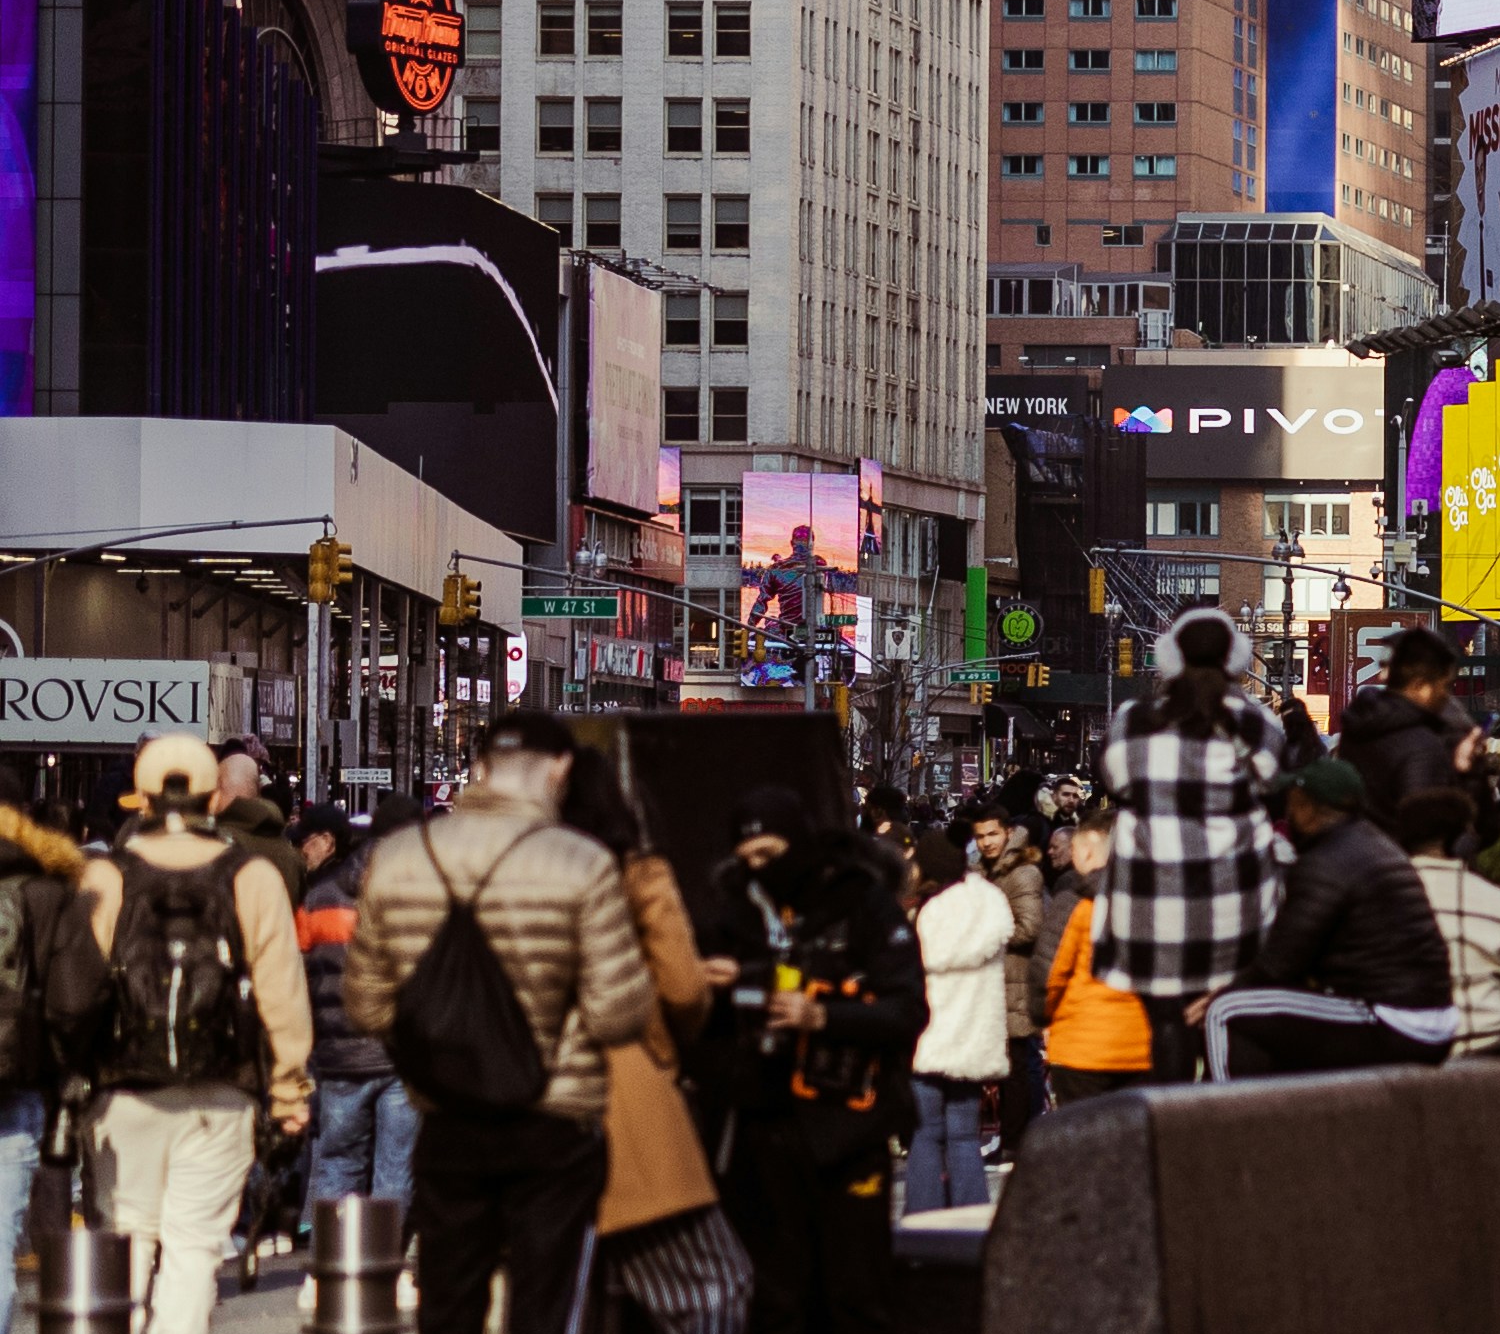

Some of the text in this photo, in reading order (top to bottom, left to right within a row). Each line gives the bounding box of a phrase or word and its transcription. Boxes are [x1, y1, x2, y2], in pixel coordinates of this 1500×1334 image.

[385, 40, 458, 65] ORIGINAL GLAZED
[402, 61, 441, 99] NOW
[985, 397, 1068, 416] NEW YORK
[1188, 407, 1385, 435] PIVO
[544, 601, 596, 614] W 47 St
[0, 677, 201, 723] ROVSKI
